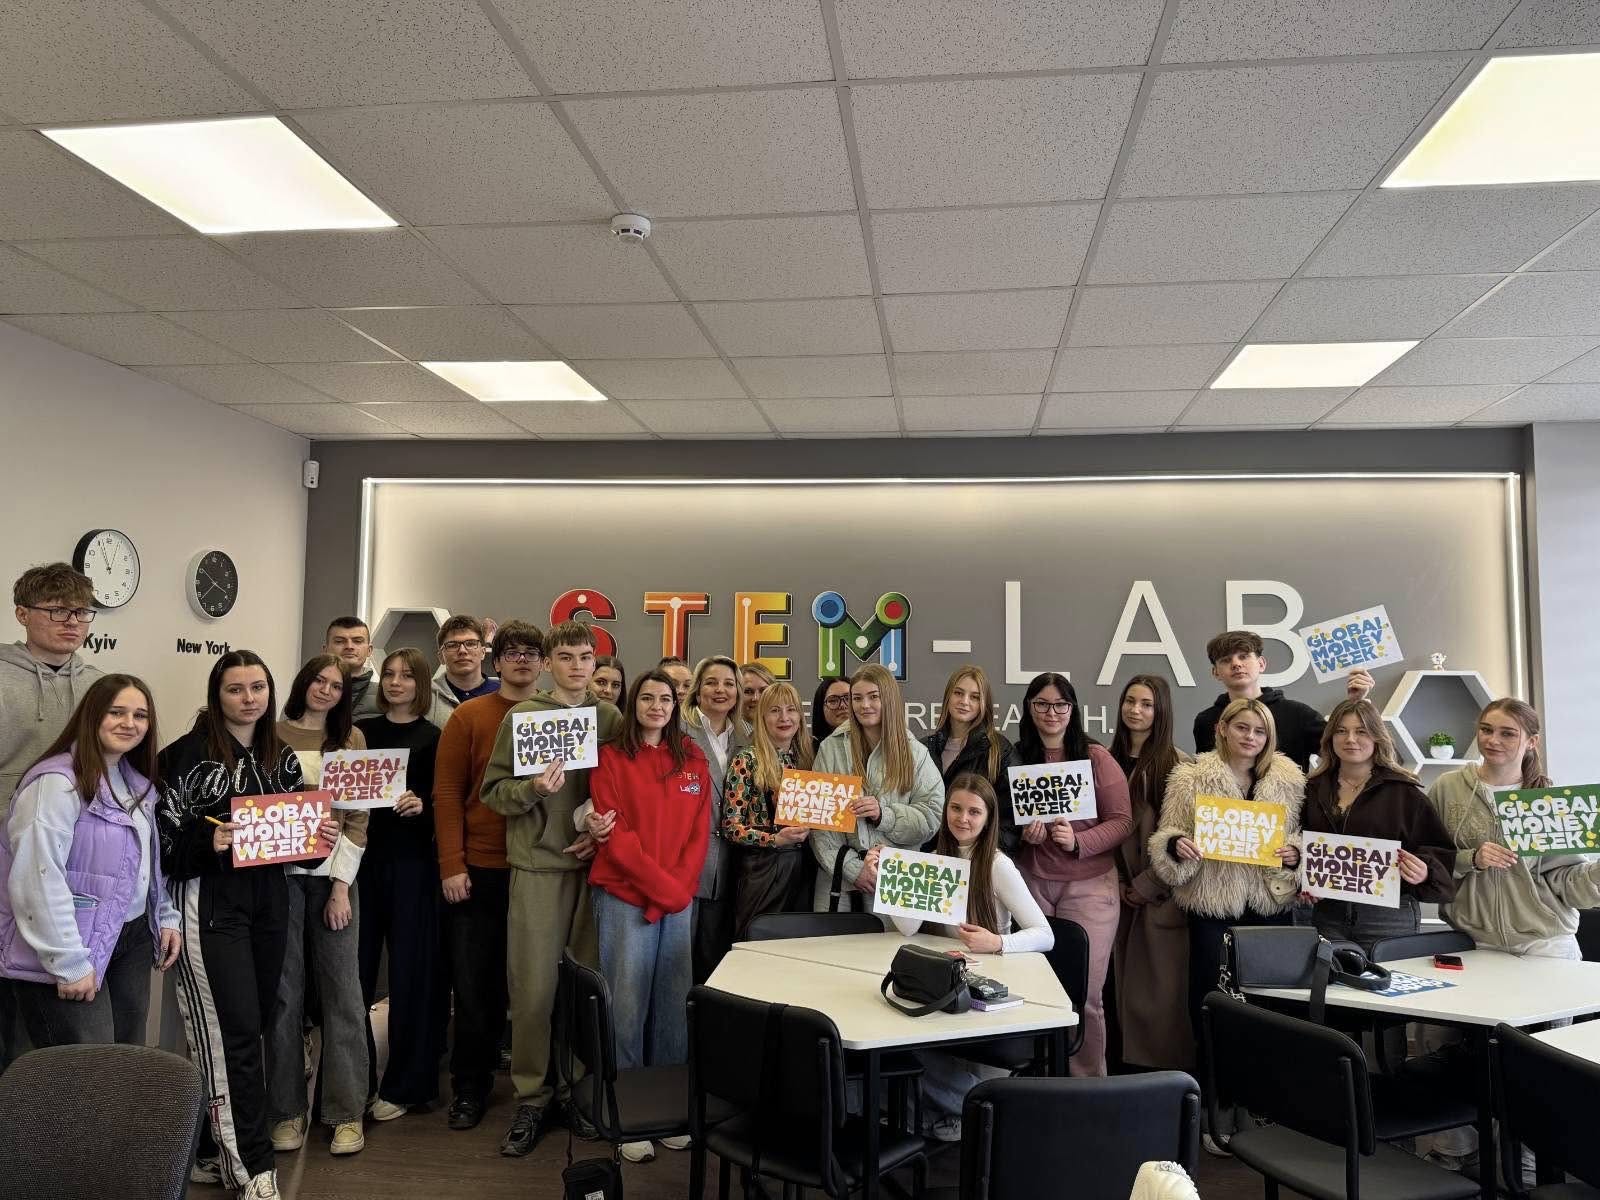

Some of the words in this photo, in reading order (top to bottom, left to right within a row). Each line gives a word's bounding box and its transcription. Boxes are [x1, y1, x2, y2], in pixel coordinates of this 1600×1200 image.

[83, 633, 117, 653] Kyiv
[176, 638, 202, 653] New
[205, 640, 231, 655] York
[1311, 632, 1383, 663] MONEY
[1315, 647, 1378, 673] WEEK
[518, 731, 588, 751] MONEY
[517, 747, 577, 766] WEEK
[322, 770, 397, 788] MONEY
[329, 785, 383, 801] WEEK
[778, 792, 852, 812] MONEY
[1014, 786, 1082, 804] MONEY
[777, 806, 835, 826] WEEK
[1015, 800, 1072, 817] WEEK
[233, 820, 322, 843] MONEY
[1195, 821, 1275, 845] MONEY
[1501, 813, 1597, 835] MONEY
[234, 837, 308, 861] WEEK
[1197, 837, 1260, 859] WEEK
[1503, 830, 1586, 852] WEEK
[1306, 858, 1390, 880] MONEY
[880, 874, 959, 899] MONEY
[1305, 871, 1373, 895] WEEK
[879, 889, 943, 913] WEEK
